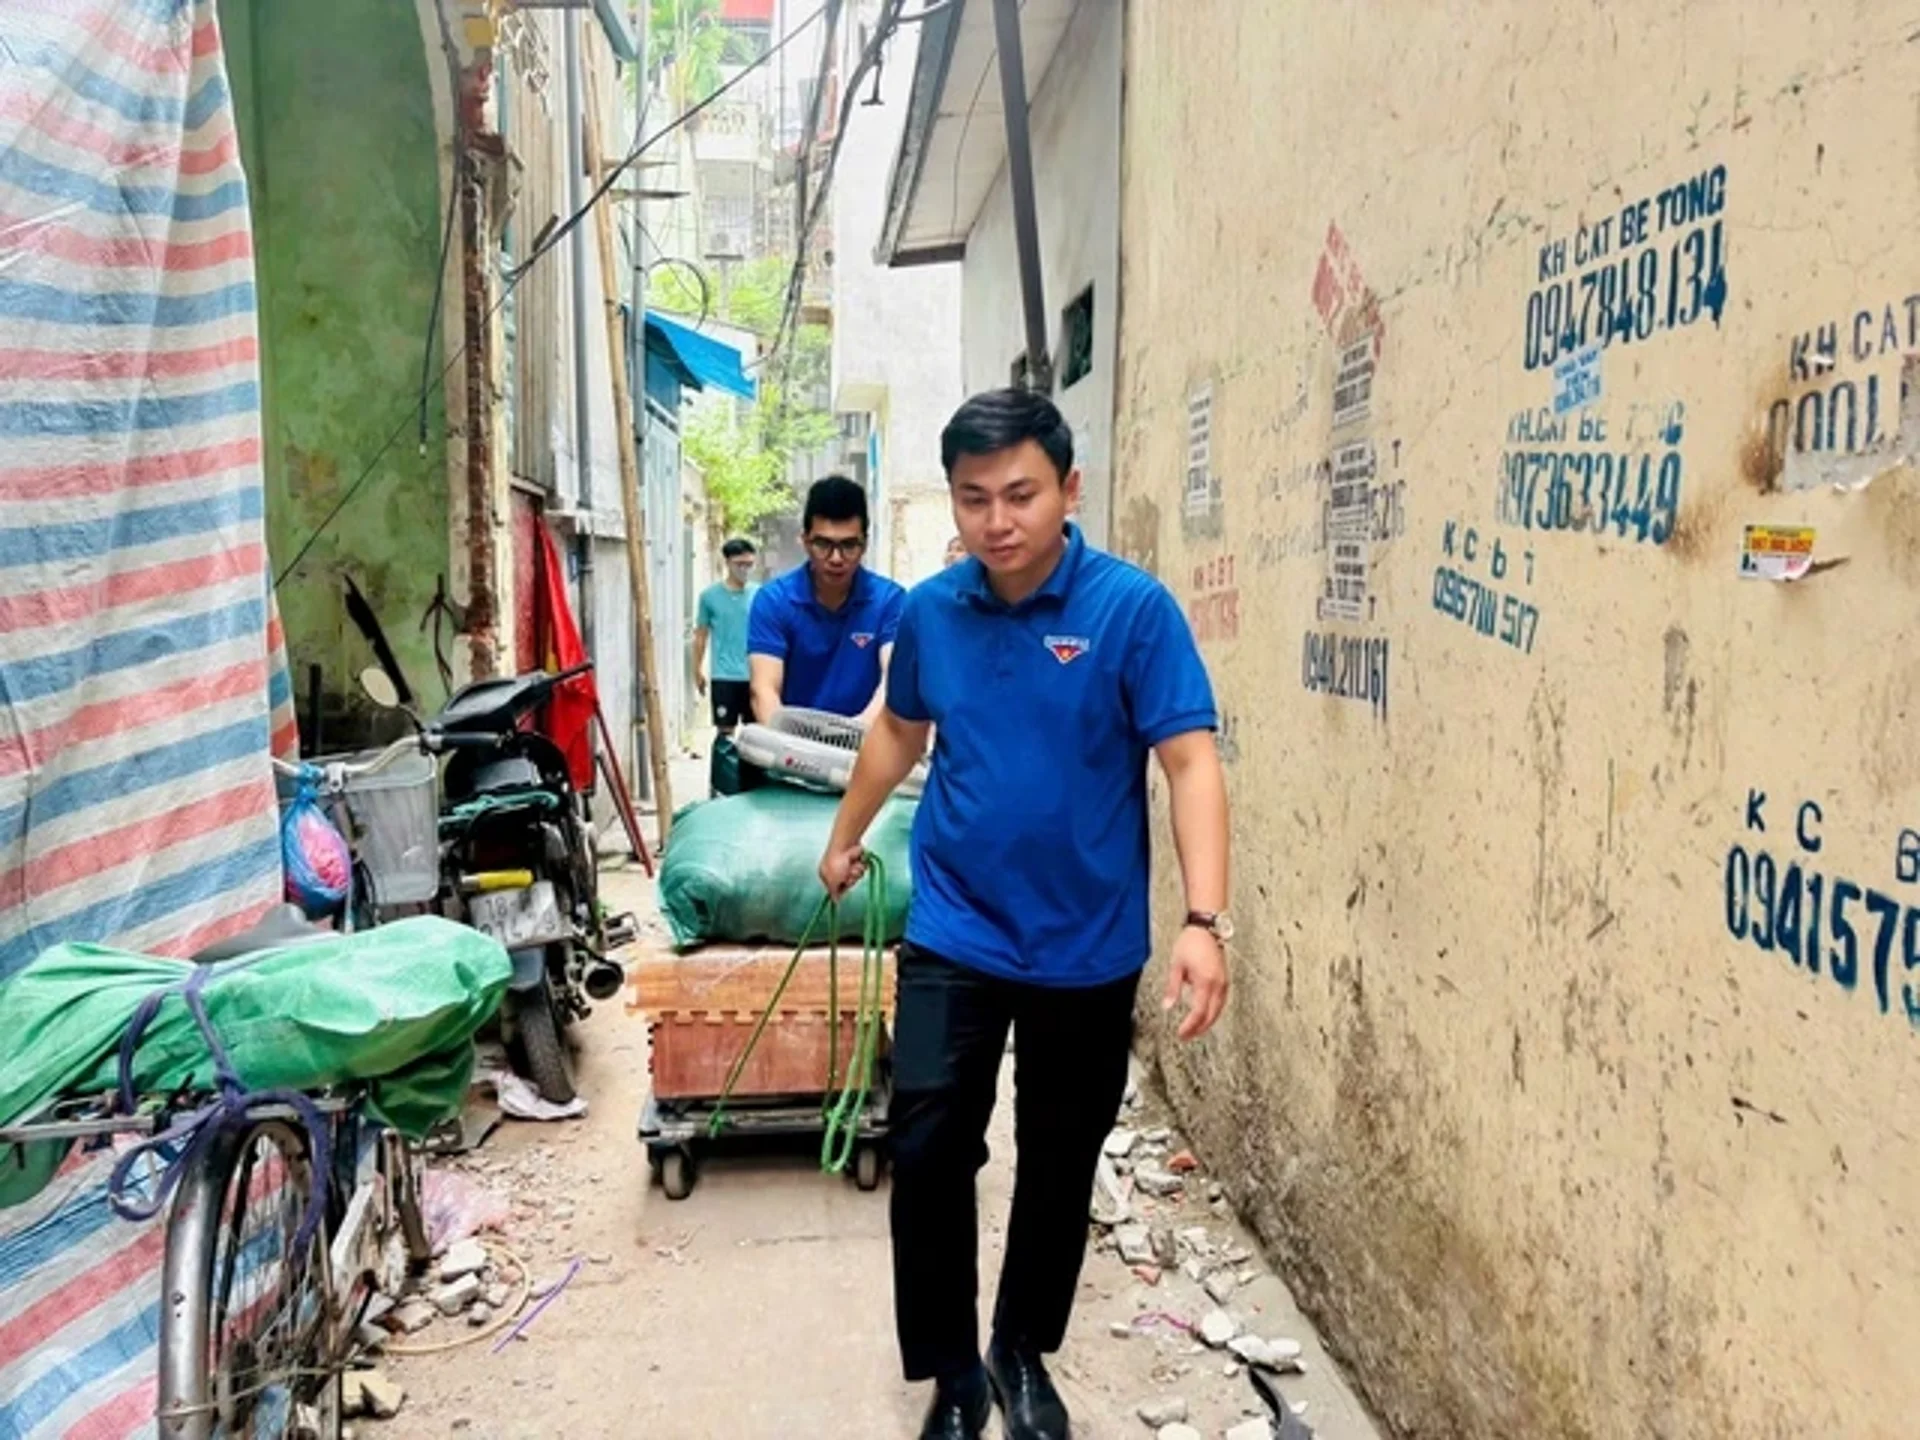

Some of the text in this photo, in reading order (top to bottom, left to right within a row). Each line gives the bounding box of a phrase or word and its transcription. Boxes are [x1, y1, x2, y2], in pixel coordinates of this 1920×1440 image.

[1538, 163, 1728, 283] KH CAT BE TONG
